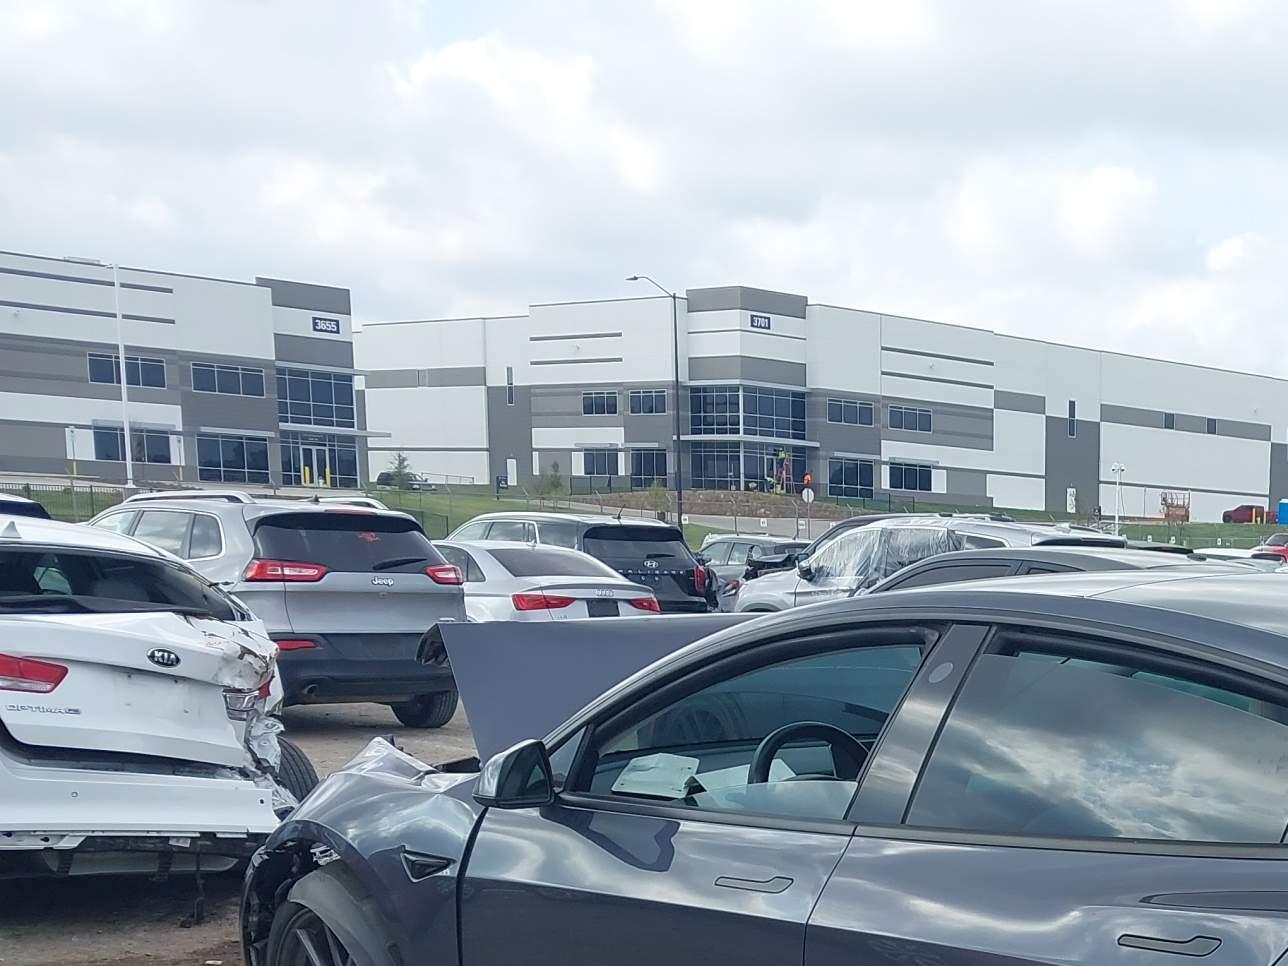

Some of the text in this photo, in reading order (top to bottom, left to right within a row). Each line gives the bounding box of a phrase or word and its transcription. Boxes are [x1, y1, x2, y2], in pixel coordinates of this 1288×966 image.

[314, 319, 337, 331] 3655
[752, 316, 769, 328] 3701
[372, 576, 394, 587] Jeep
[153, 650, 177, 665] KIA
